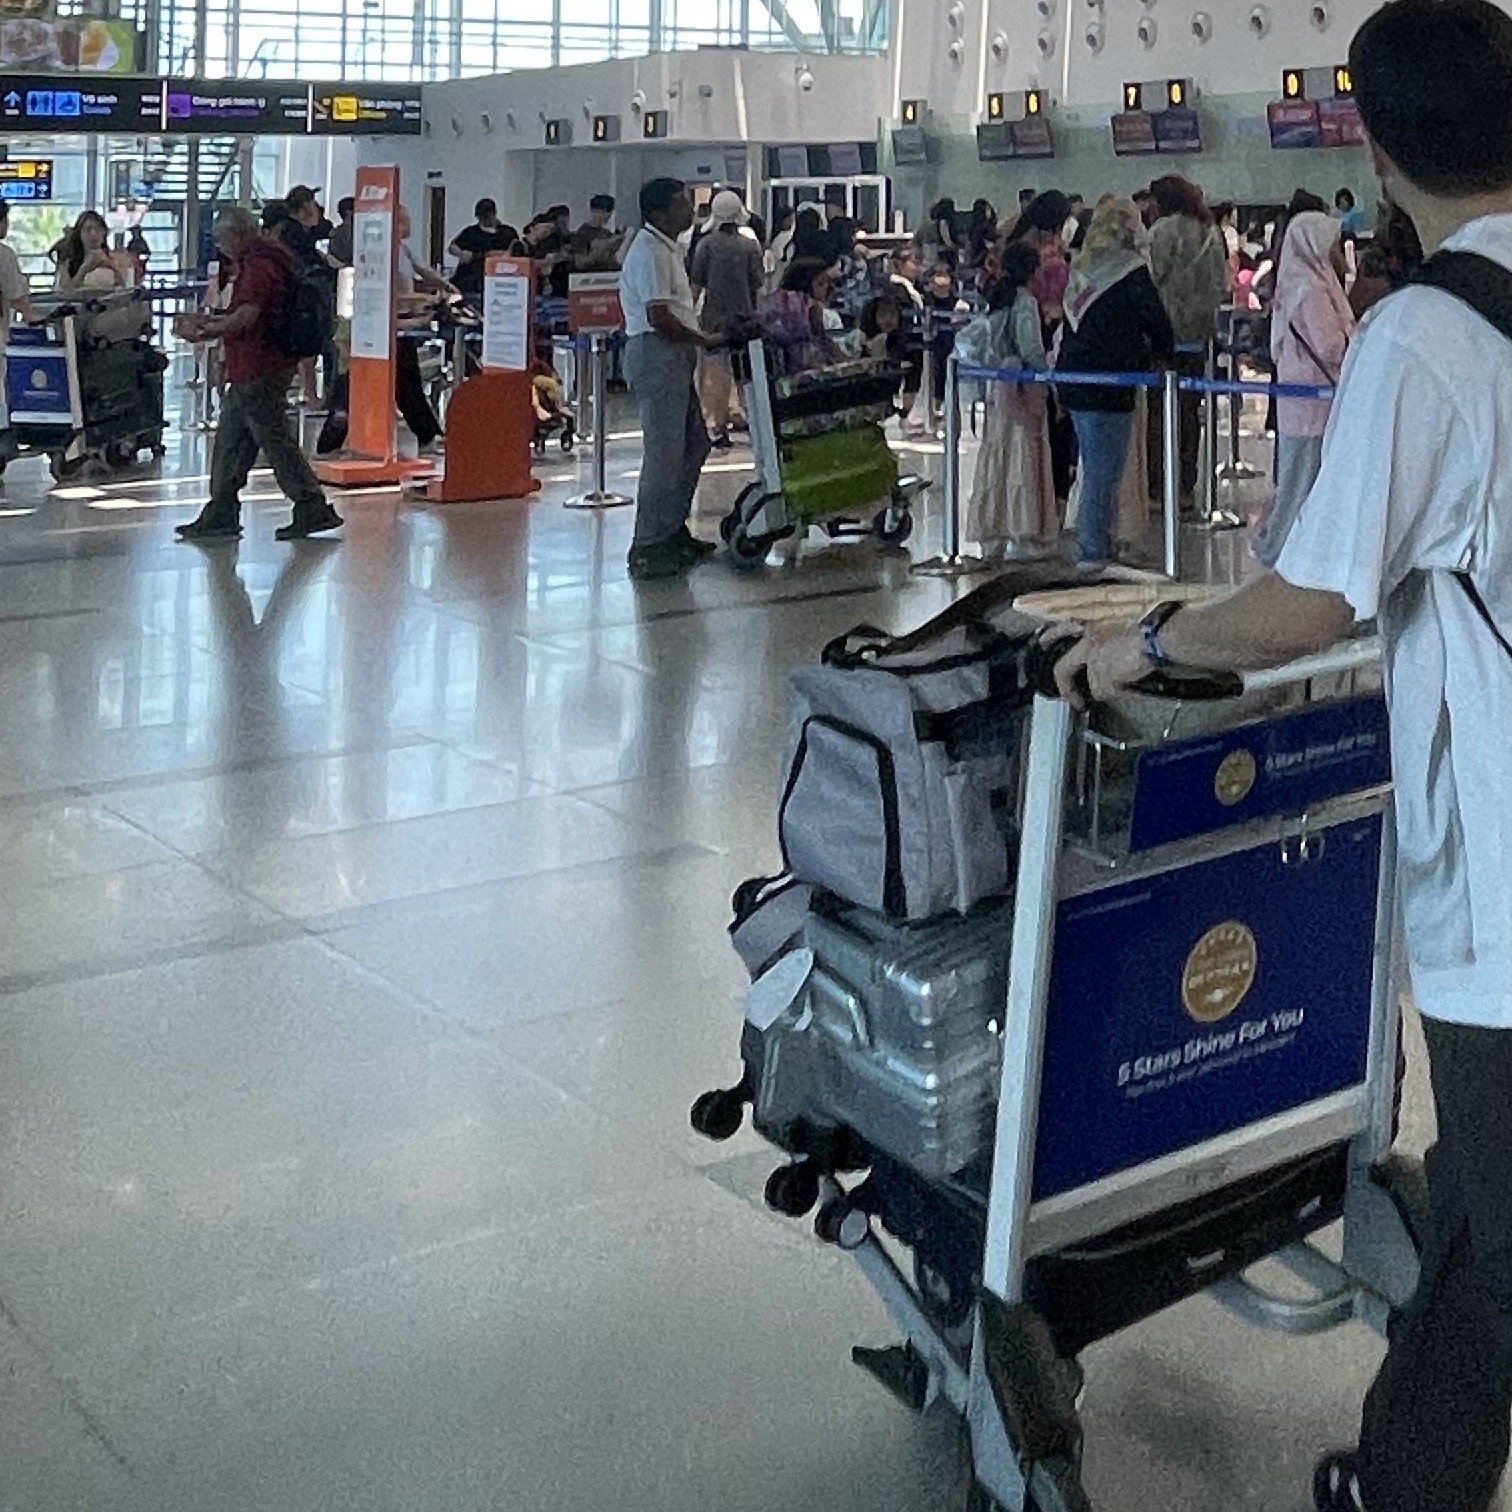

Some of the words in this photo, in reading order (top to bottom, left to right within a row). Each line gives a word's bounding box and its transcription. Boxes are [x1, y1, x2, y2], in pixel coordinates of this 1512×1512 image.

[1132, 1048, 1182, 1080] Stars
[1183, 1030, 1236, 1064] Shine
[1239, 1018, 1268, 1044] For
[1271, 1008, 1304, 1033] You
